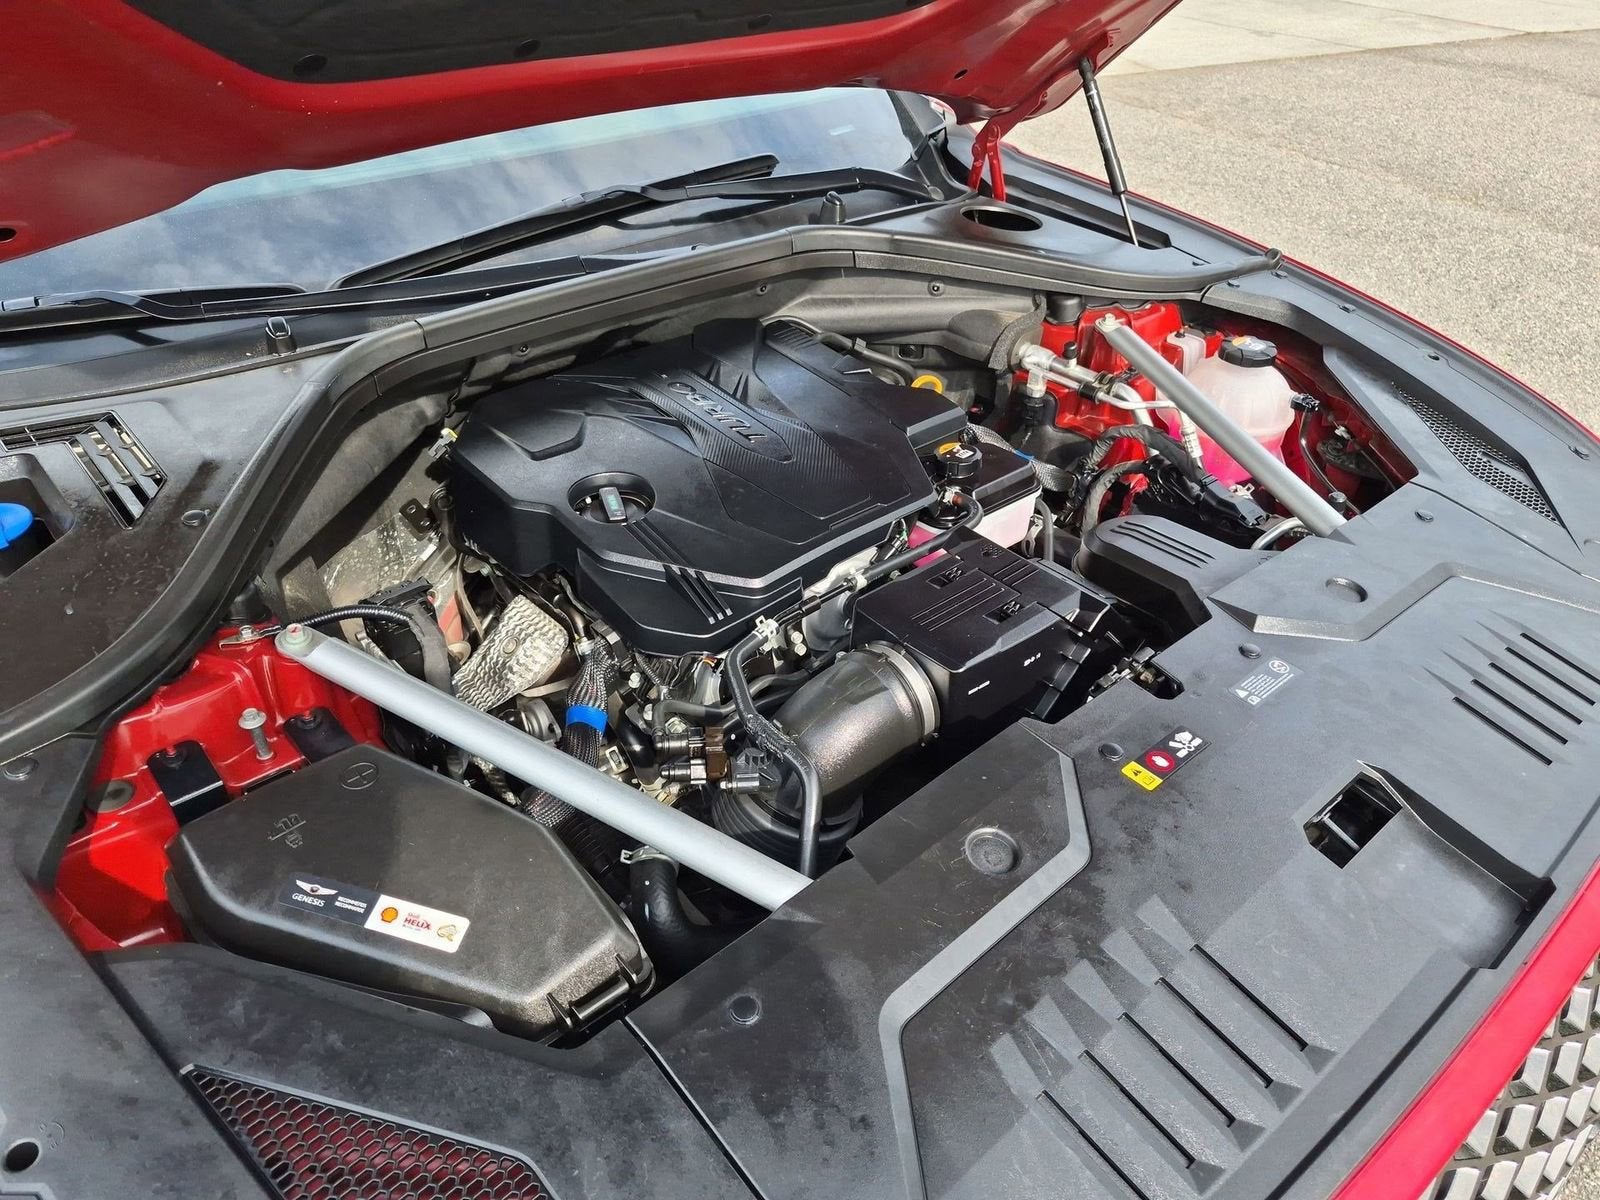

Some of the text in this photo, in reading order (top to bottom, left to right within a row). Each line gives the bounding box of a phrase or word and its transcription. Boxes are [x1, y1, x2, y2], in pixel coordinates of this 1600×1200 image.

[668, 382, 767, 443] TURBO
[292, 893, 326, 907] GENESIS
[403, 917, 432, 930] HELIX
